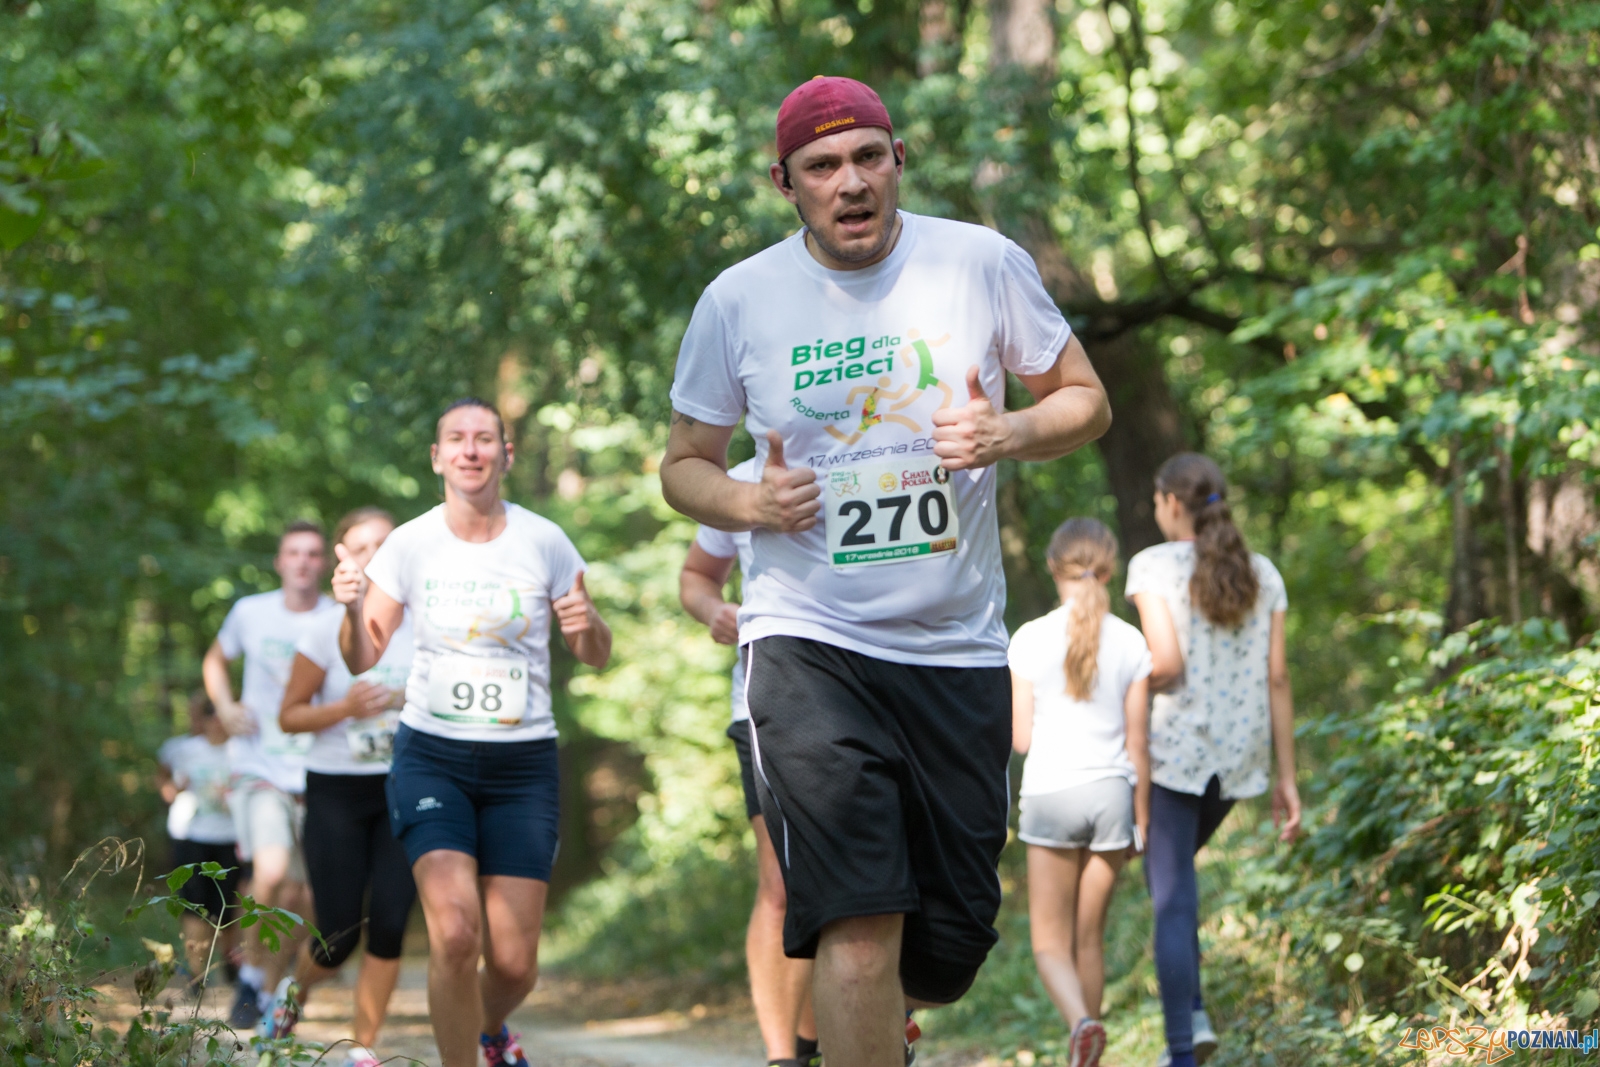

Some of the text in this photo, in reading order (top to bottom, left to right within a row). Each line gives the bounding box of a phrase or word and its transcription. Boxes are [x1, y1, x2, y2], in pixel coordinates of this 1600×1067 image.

[814, 116, 856, 134] REDSKINS
[791, 335, 901, 367] Bieg dla
[793, 350, 894, 391] Dzieci
[789, 396, 850, 421] Roberta
[807, 437, 936, 468] 17 września 20
[838, 490, 949, 547] 270
[452, 682, 503, 712] 98
